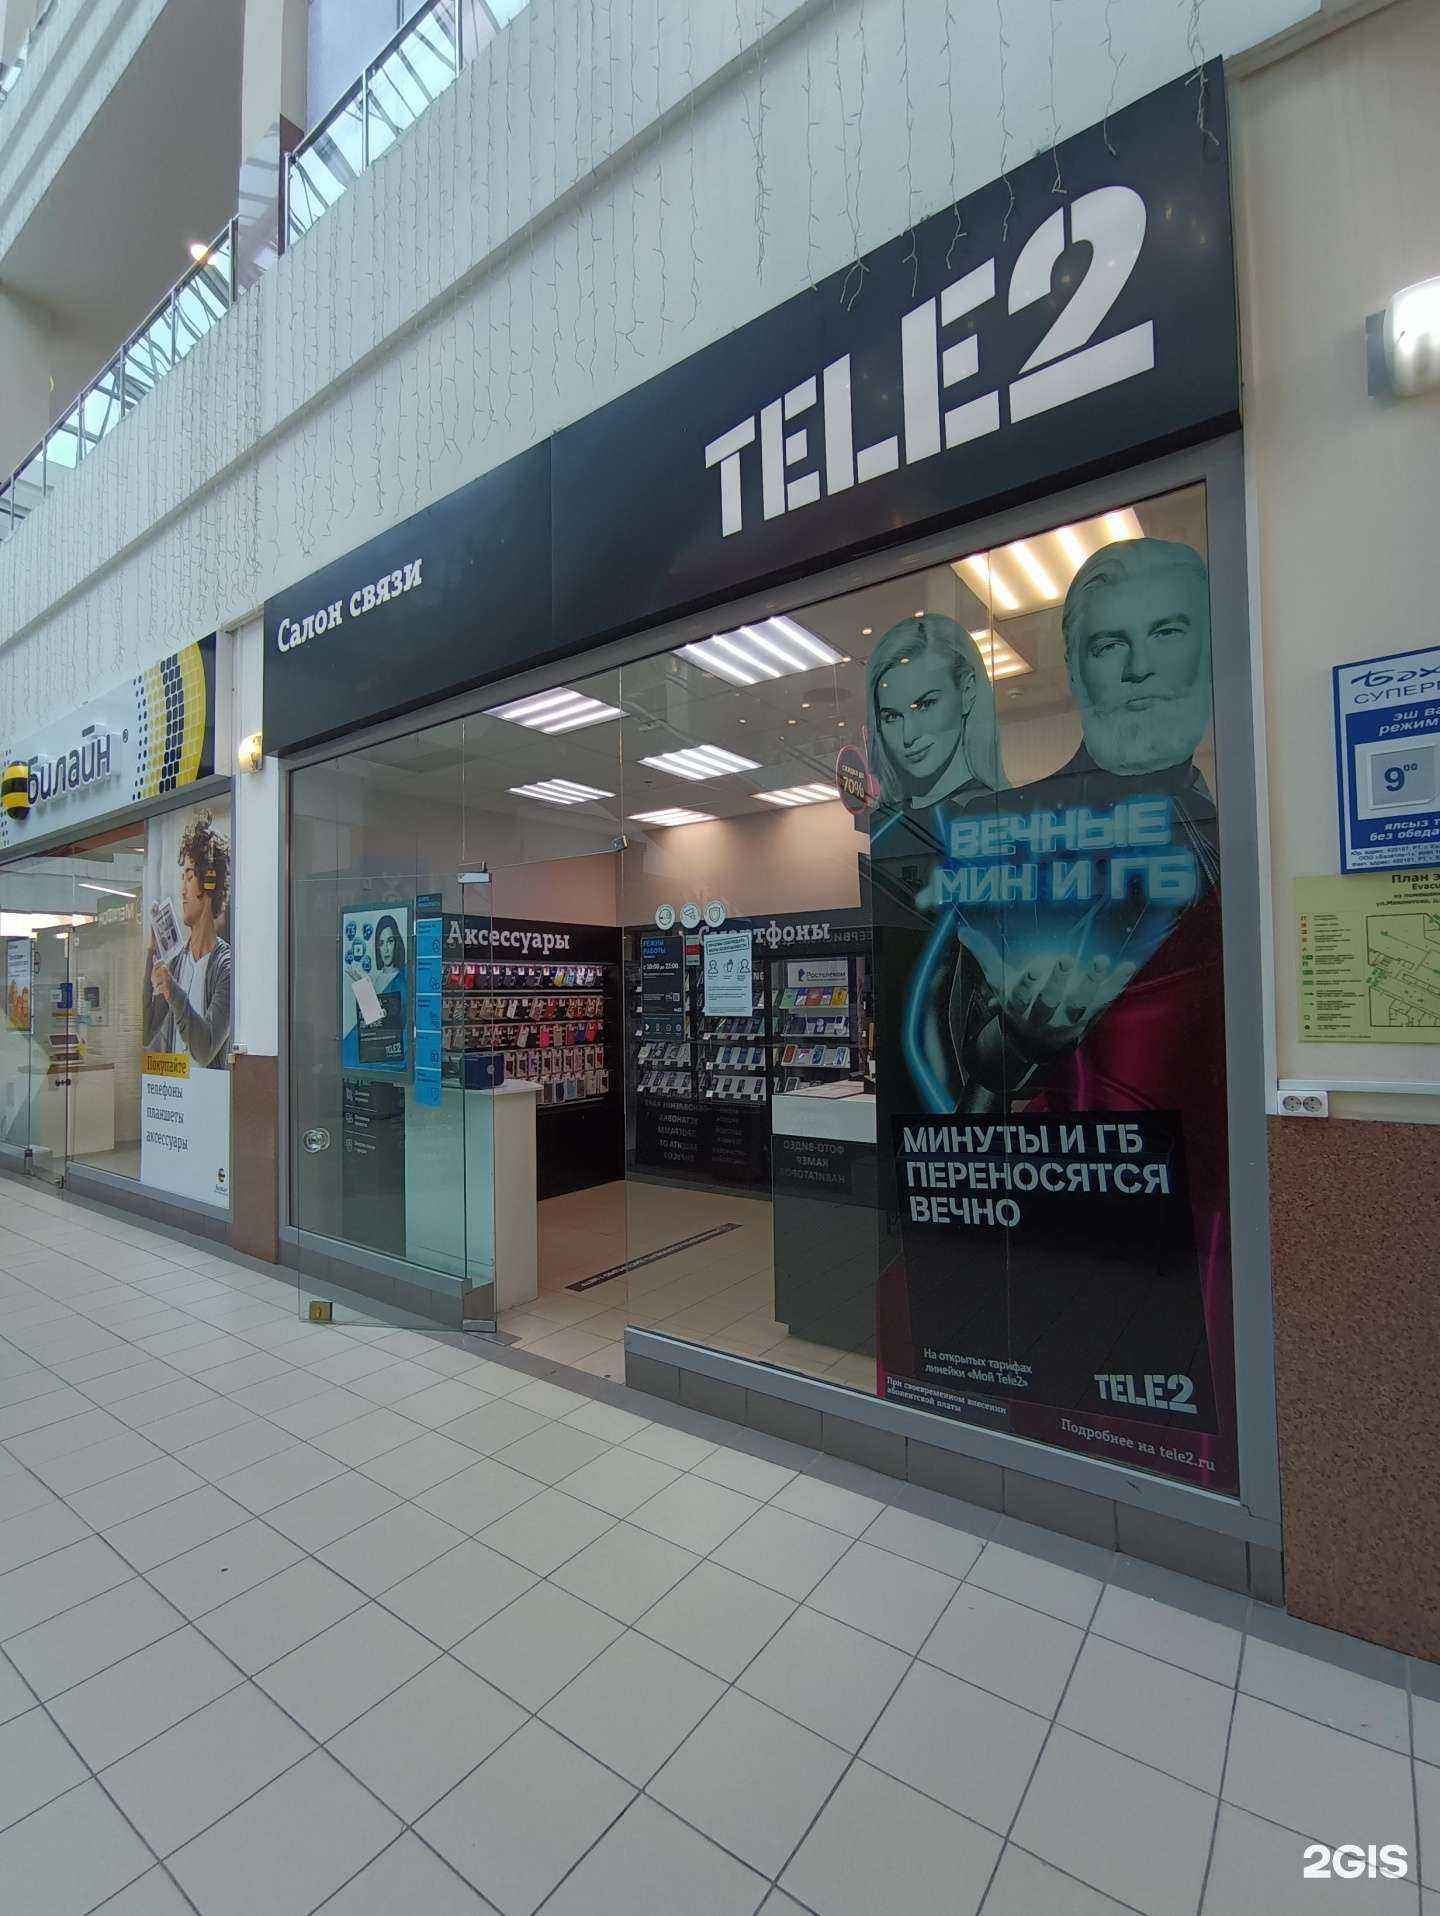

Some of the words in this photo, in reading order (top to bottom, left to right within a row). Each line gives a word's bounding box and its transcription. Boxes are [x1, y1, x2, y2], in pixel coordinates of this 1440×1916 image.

[704, 186, 1155, 537] TELE2
[277, 600, 343, 652] Салон
[349, 558, 423, 617] связи
[951, 800, 1171, 858] ВЕЧНЫЕ
[1370, 832, 1393, 841] без
[1398, 828, 1440, 838] обеда
[935, 863, 1038, 903] МИН
[1053, 860, 1091, 900] И
[1110, 855, 1193, 900] ГБ
[1391, 874, 1429, 883] План
[447, 920, 570, 955] Аксессуары
[147, 1056, 187, 1075] Покупайте
[147, 1082, 183, 1100] телефоны
[146, 1107, 184, 1124] планшеты
[146, 1130, 188, 1152] аксессуары
[903, 1125, 1049, 1153] МИНУТЫ
[1059, 1124, 1085, 1153] И
[1096, 1124, 1143, 1153] ГБ
[906, 1161, 1170, 1194] ПЕРЕНОСЯТСЯ
[909, 1195, 1021, 1227] ВЕЧНО
[924, 1347, 937, 1360] На
[938, 1353, 986, 1368] открытых
[1094, 1374, 1198, 1414] TELE2
[1061, 1418, 1135, 1448] Подробнее
[1138, 1441, 1155, 1455] на
[1160, 1445, 1215, 1471] tele2.ru
